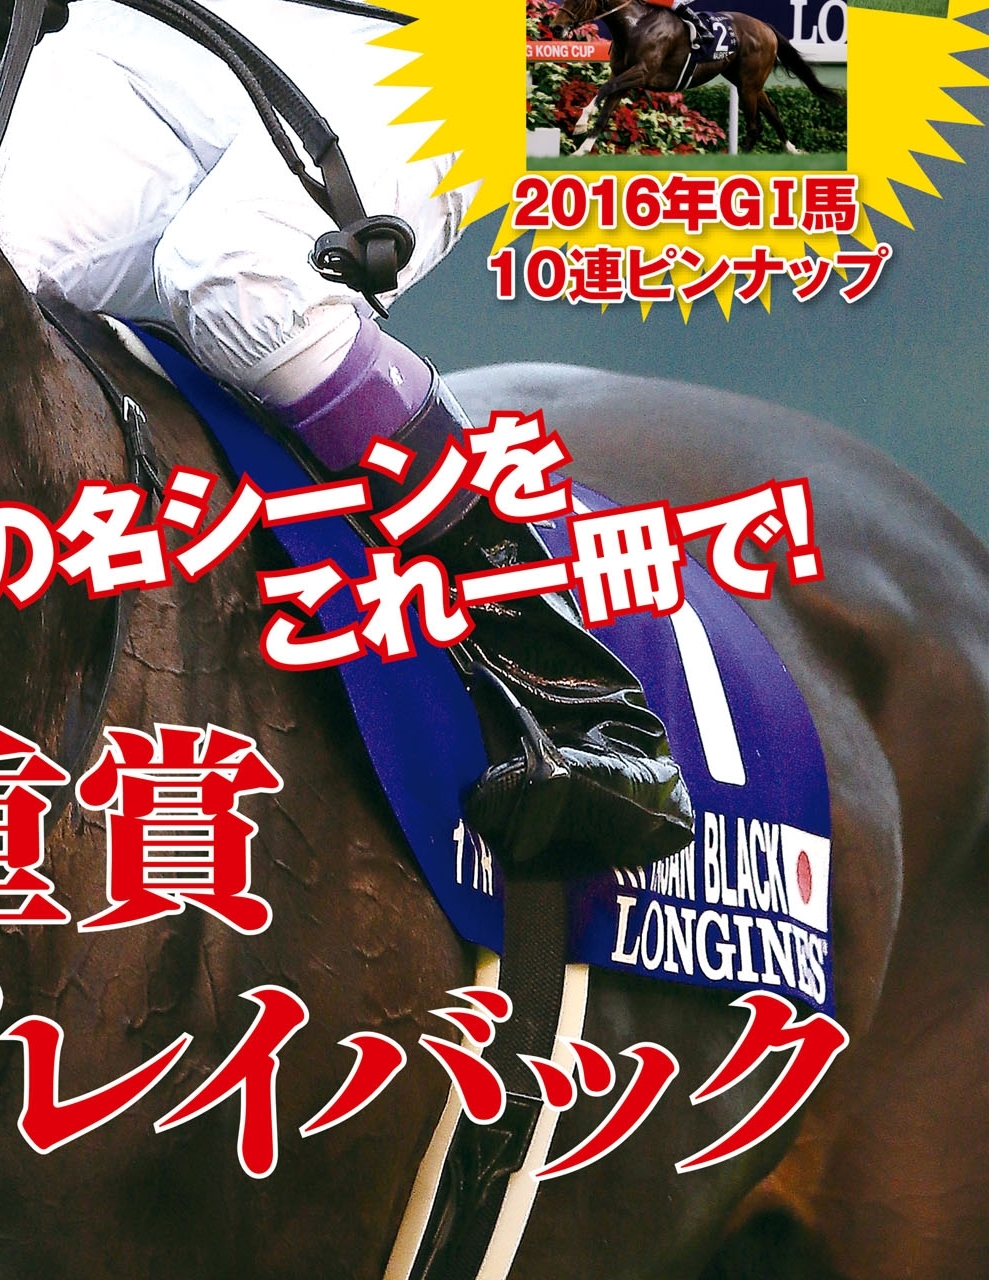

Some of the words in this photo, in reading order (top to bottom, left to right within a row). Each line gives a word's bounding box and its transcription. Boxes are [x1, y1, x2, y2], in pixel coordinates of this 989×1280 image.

[535, 44, 569, 58] KONG
[571, 45, 596, 58] CUP
[712, 21, 729, 52] 2
[703, 810, 790, 916] BLACK
[611, 894, 828, 1006] LONGINES
